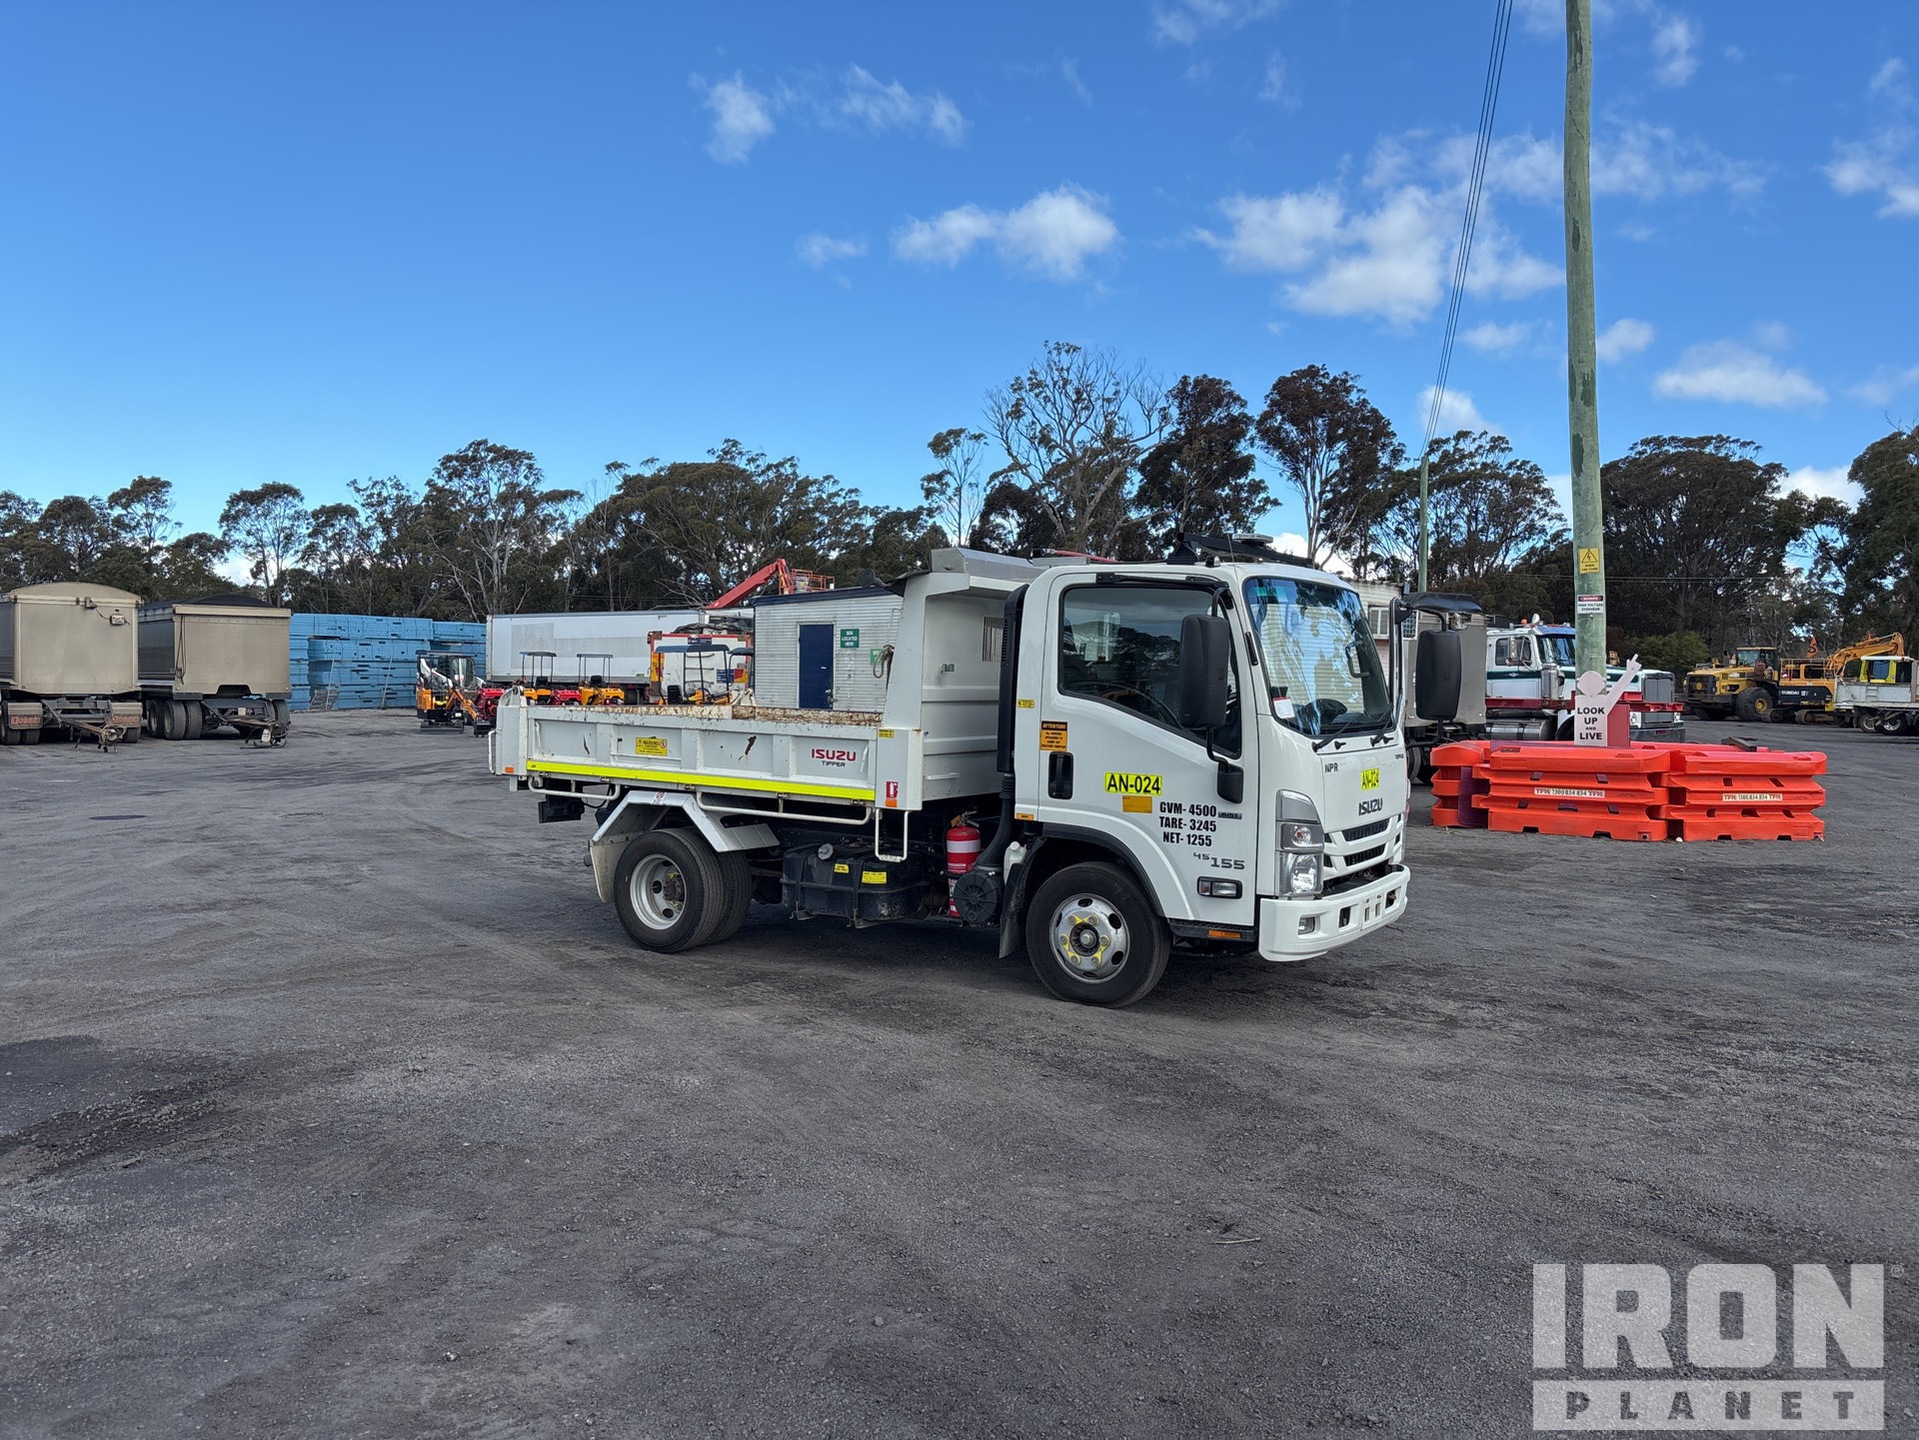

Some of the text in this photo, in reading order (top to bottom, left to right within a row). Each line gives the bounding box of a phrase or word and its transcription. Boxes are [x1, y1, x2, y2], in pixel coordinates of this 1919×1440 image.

[1577, 706, 1605, 715] LOOK
[1584, 717, 1598, 725] UP
[1580, 732, 1602, 740] LIVE
[811, 748, 857, 762] ISUZU
[821, 760, 846, 768] TIPPER
[1324, 762, 1339, 774] NPR
[1106, 773, 1161, 793] AN-024
[1159, 801, 1187, 814] GVM-
[1188, 803, 1217, 817] 4500
[1358, 797, 1383, 817] ISUZU
[1159, 816, 1217, 832] TARE- 3245
[1163, 831, 1212, 847] NET- 1255
[1193, 851, 1245, 870] 45 155
